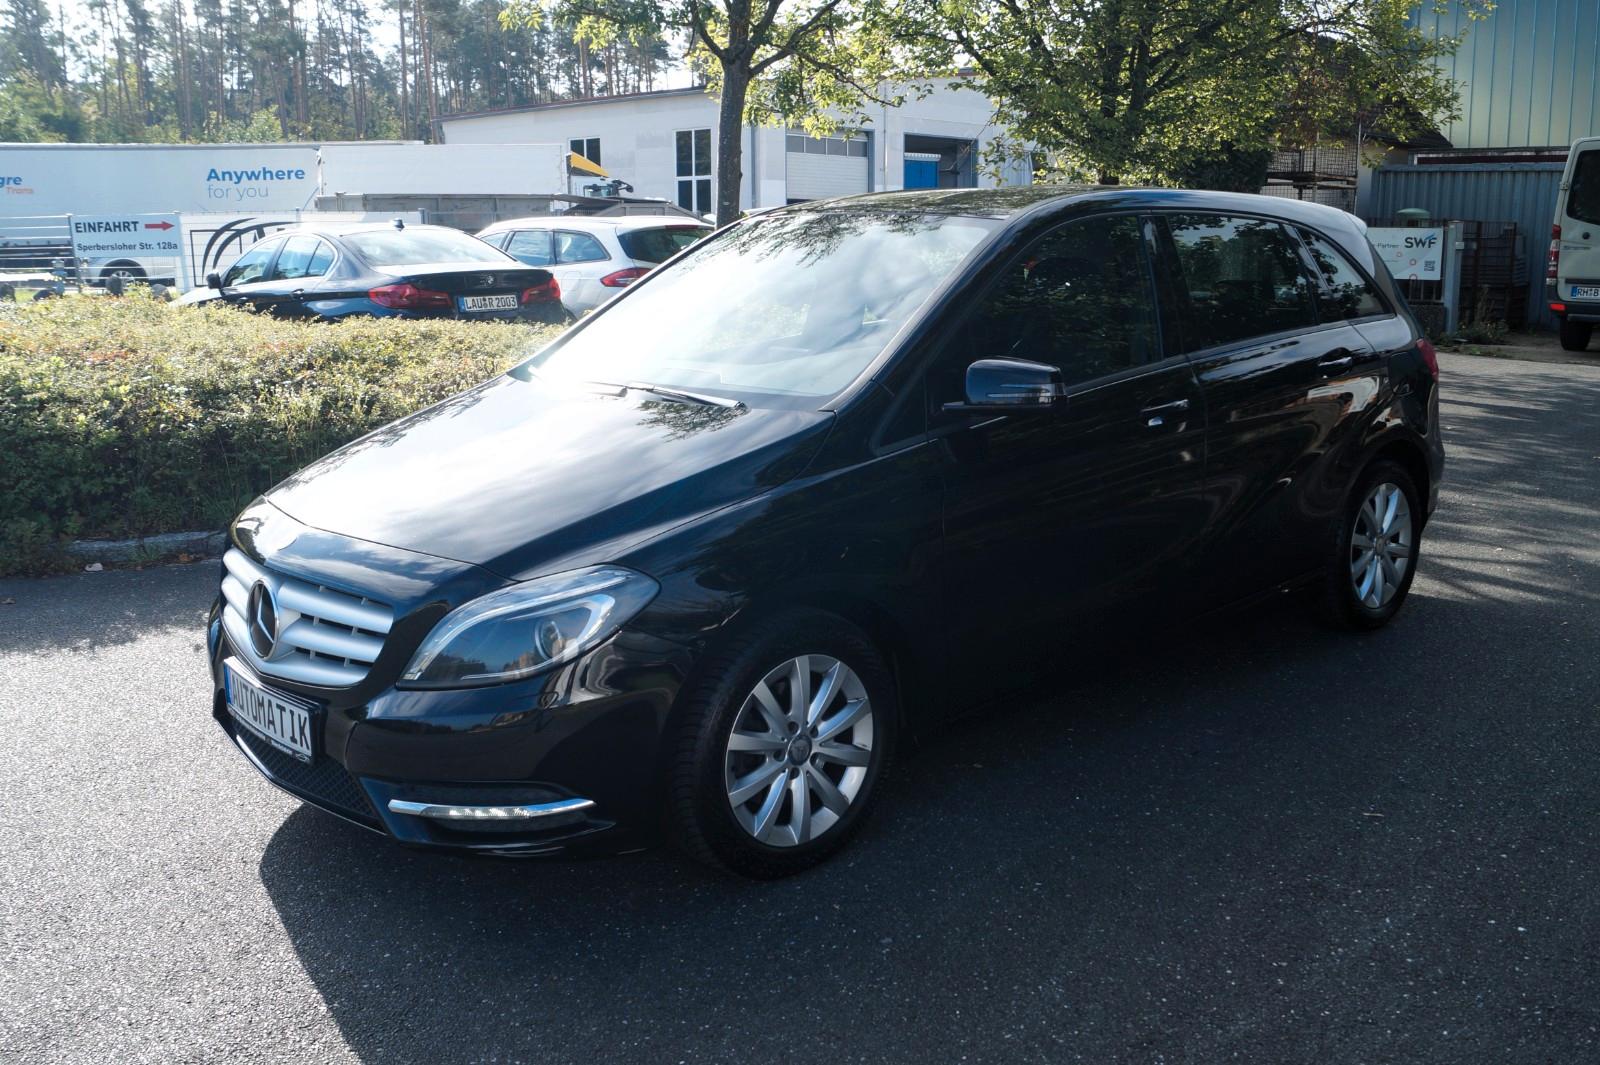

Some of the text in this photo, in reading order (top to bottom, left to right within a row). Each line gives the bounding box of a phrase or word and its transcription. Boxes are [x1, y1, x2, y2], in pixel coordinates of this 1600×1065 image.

[206, 167, 305, 184] Anywhere
[208, 184, 269, 201] for you
[75, 221, 139, 233] EINFAHRT
[77, 242, 178, 252] Sperbersloher Str. 128a
[1404, 236, 1437, 249] SWF
[465, 296, 516, 309] LAU R 2003
[231, 674, 310, 750] AUTOMATIK
